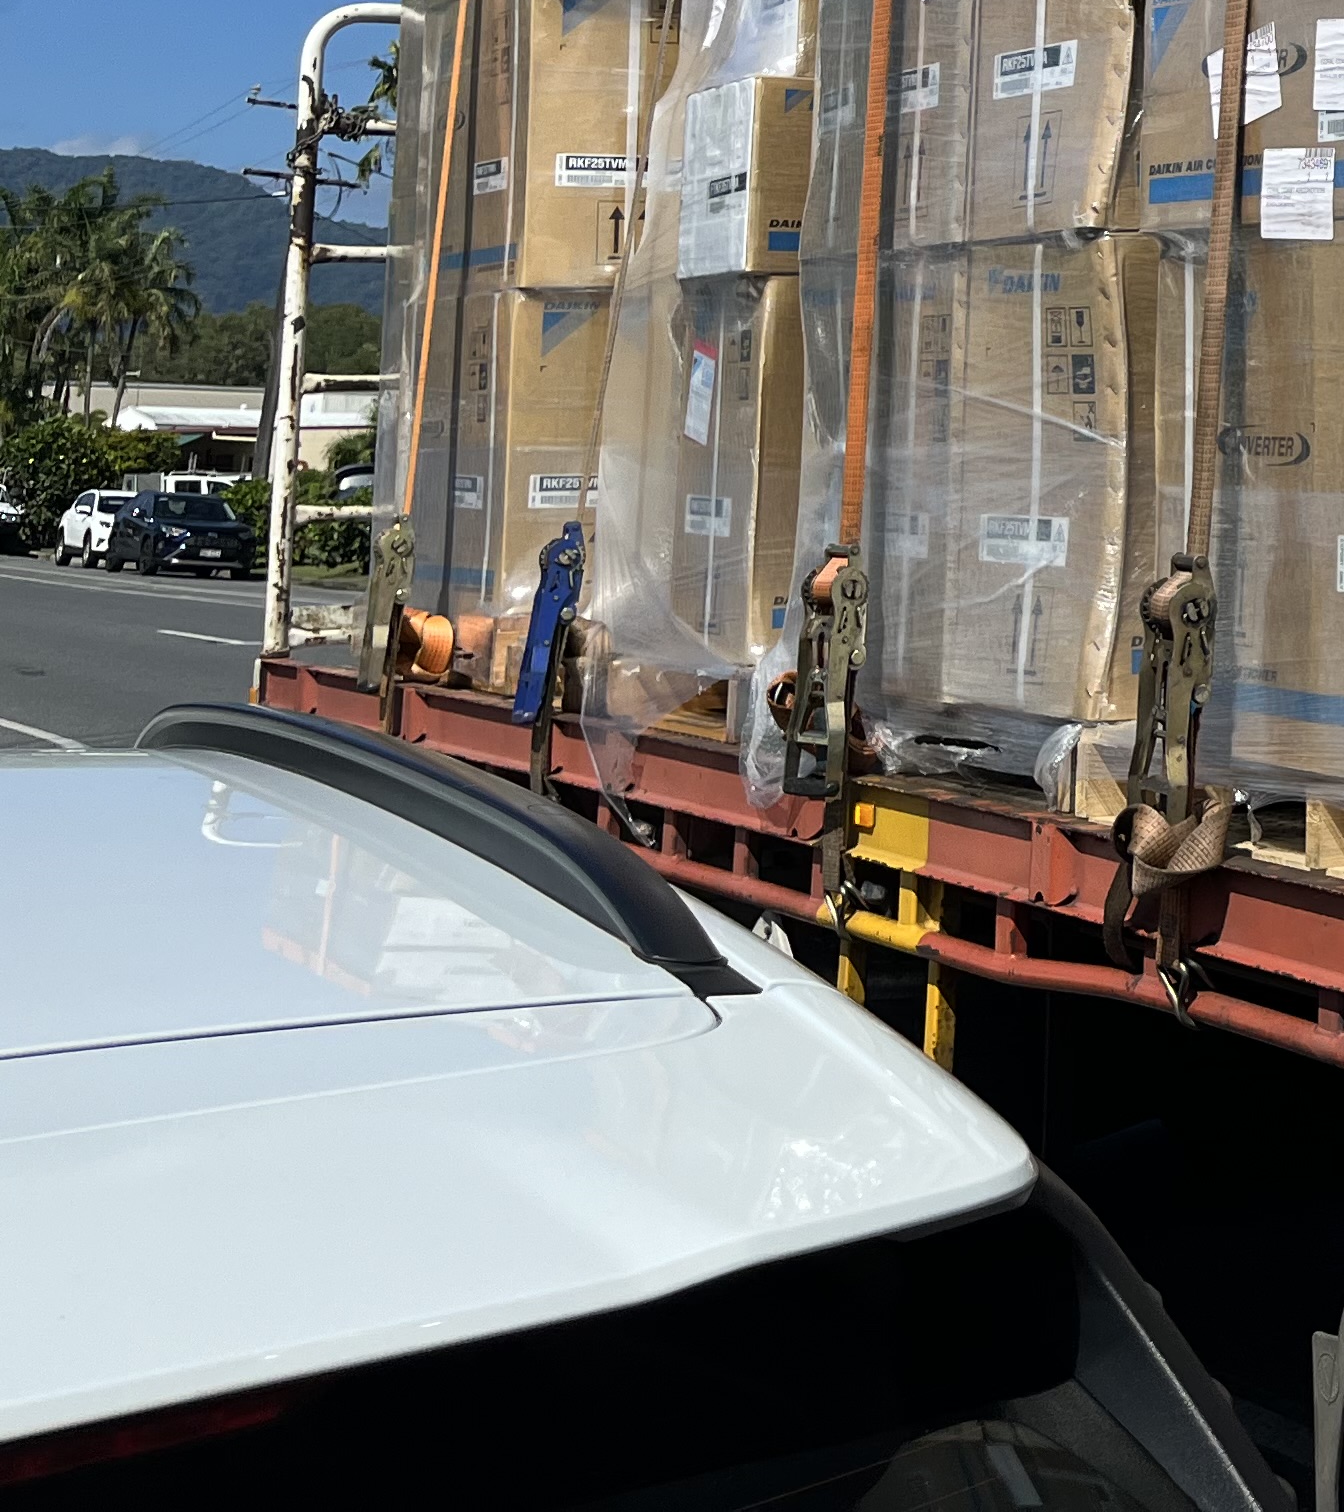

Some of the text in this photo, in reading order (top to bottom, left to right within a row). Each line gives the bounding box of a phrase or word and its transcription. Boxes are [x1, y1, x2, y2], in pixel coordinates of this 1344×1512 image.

[568, 157, 628, 171] RKF25TVM
[1150, 161, 1182, 176] DAIKIN
[1186, 160, 1201, 173] AIR
[769, 219, 801, 229] DAI
[544, 300, 600, 310] DAIKIN
